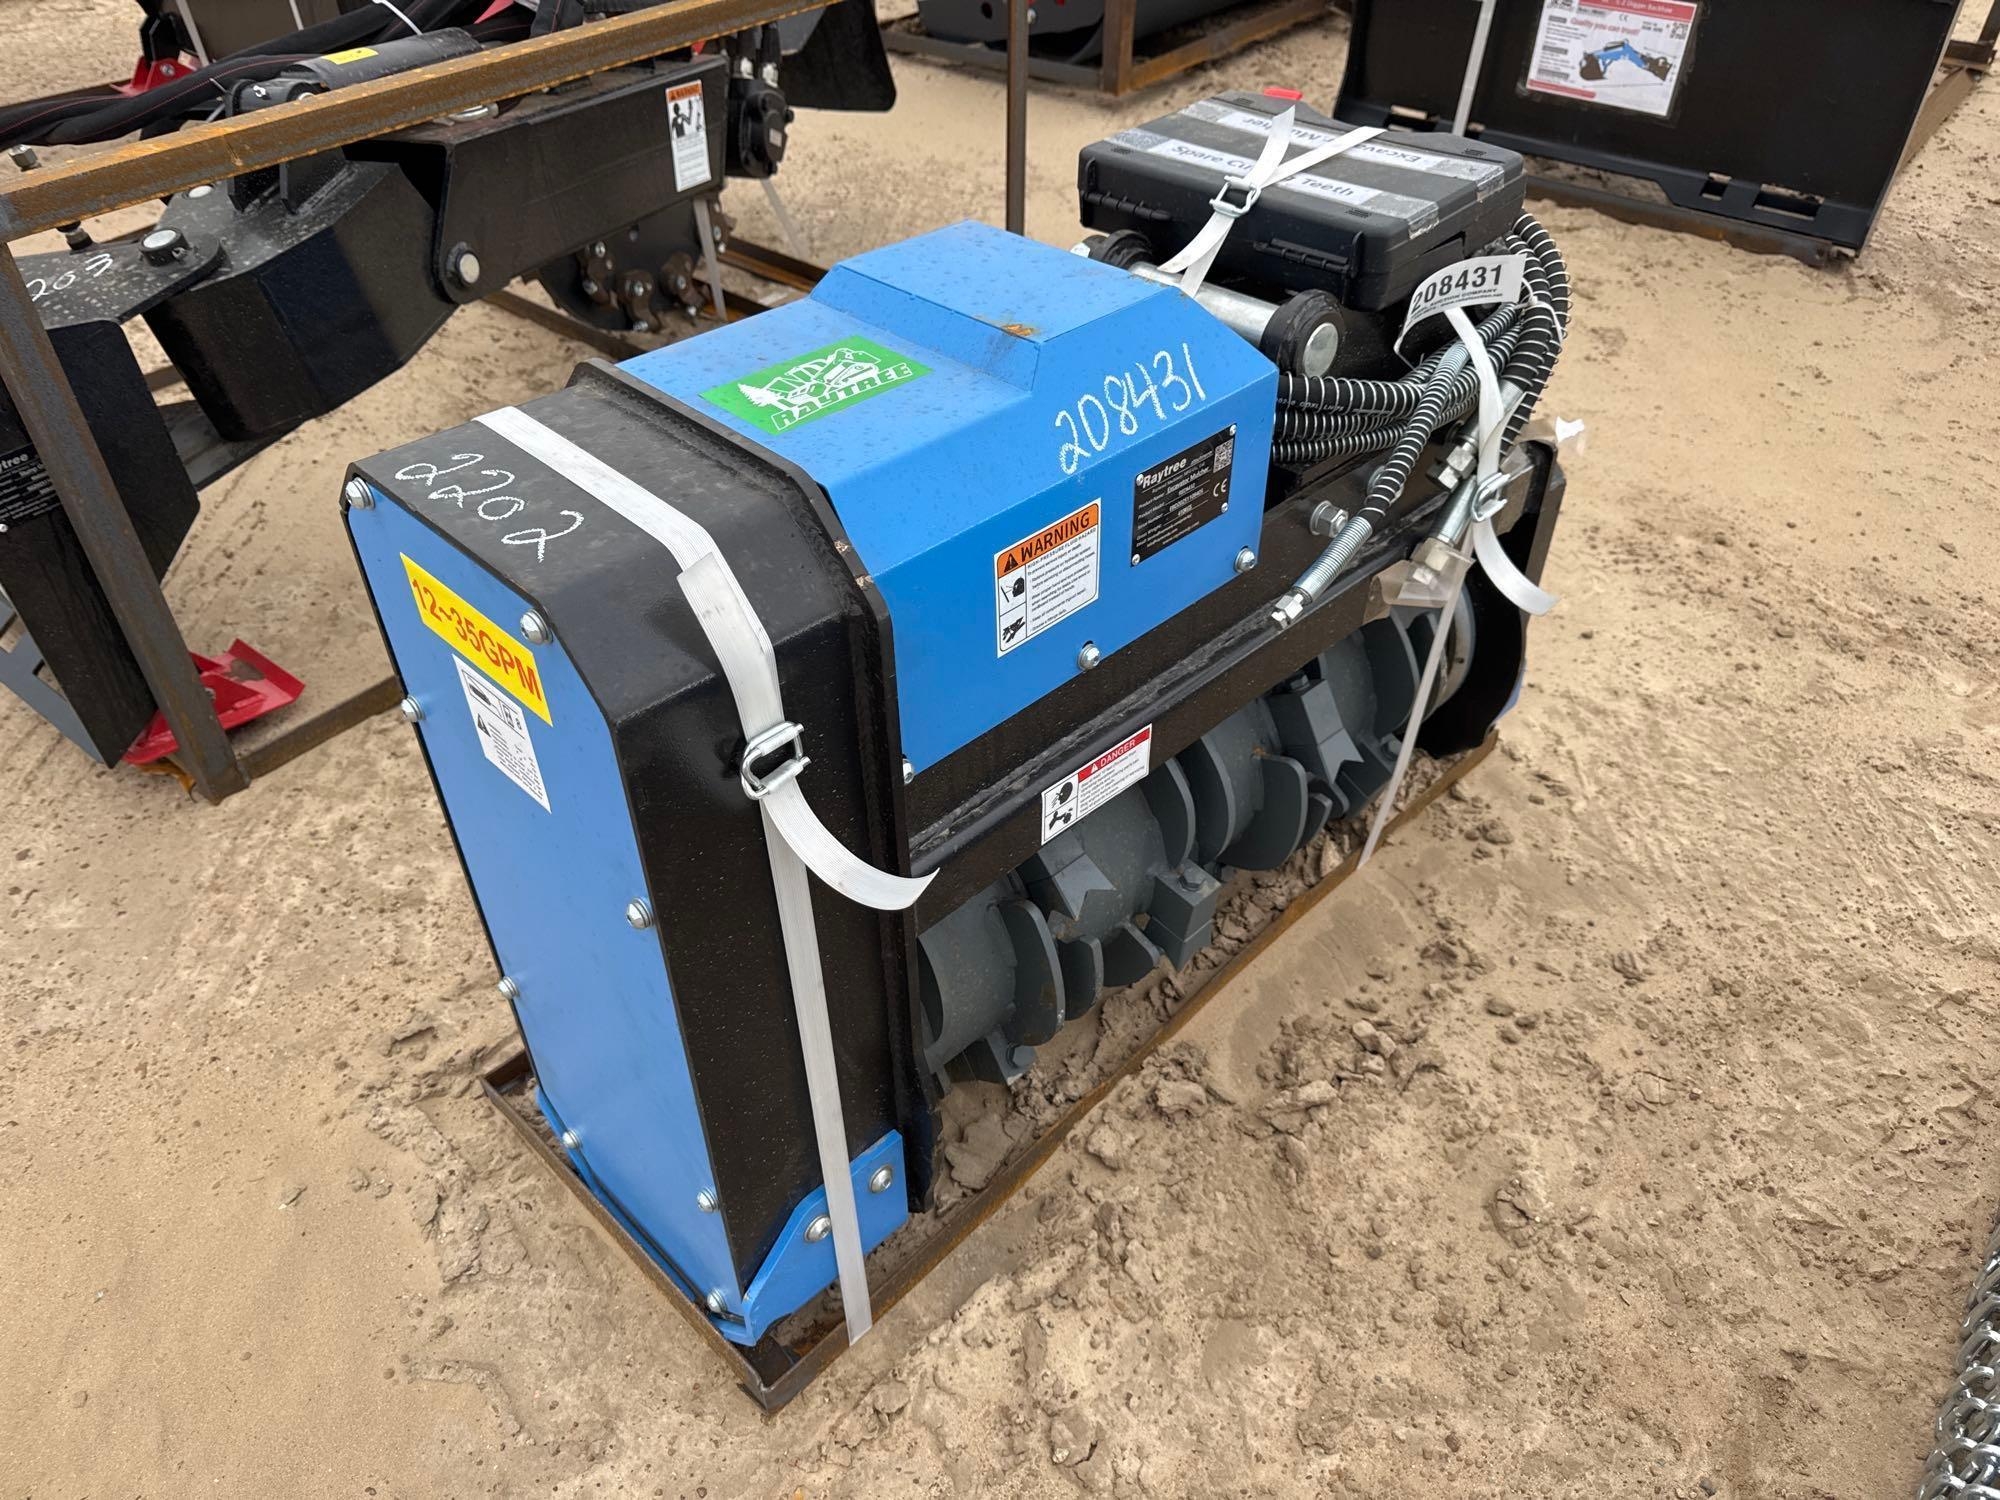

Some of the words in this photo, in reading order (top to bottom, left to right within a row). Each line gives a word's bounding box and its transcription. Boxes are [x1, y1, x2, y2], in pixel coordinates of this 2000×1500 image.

[1171, 146, 1223, 163] Spare
[1301, 178, 1355, 196] Teeth
[1411, 264, 1502, 314] 208431
[1055, 343, 1206, 475] 208431
[1142, 458, 1187, 489] Raytree
[395, 453, 584, 563] 2202
[1020, 511, 1090, 563] WARNING
[1100, 739, 1136, 767] DANGER
